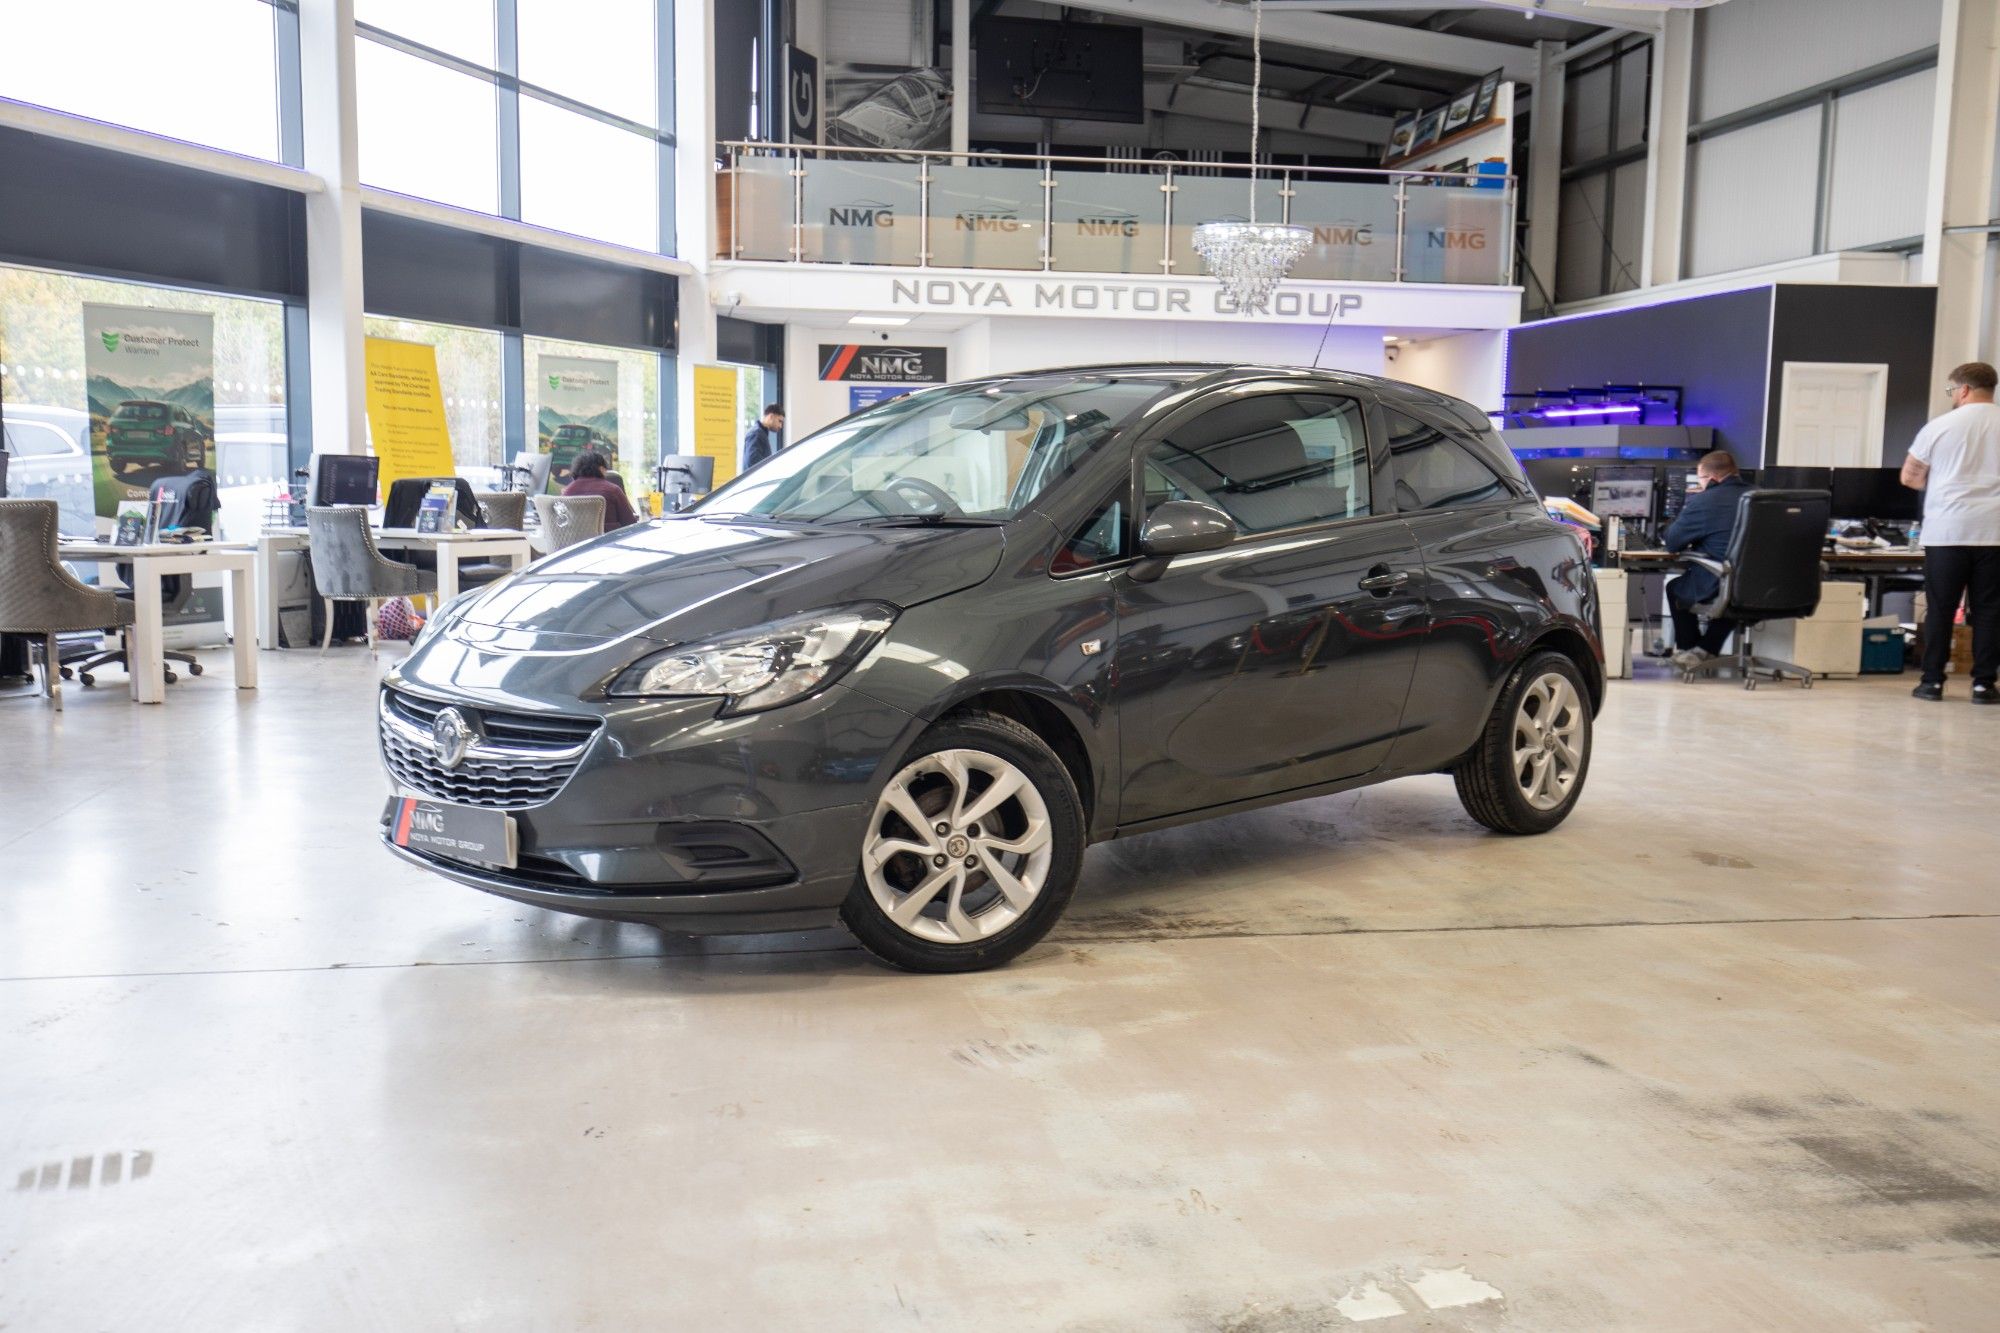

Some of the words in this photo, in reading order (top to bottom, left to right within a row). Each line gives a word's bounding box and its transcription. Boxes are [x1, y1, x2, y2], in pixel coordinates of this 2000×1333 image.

[829, 207, 894, 228] NMG
[955, 213, 1019, 233] NMG
[1077, 218, 1140, 237] NMG
[1313, 226, 1373, 246] NMG
[1427, 231, 1486, 249] NMG
[892, 279, 1012, 307] NOYA
[1035, 284, 1191, 312] MOTOR
[124, 334, 166, 346] Customer
[168, 337, 200, 347] Protect
[860, 356, 923, 375] NMG
[409, 810, 445, 833] NMG
[410, 832, 430, 843] NOYA
[430, 836, 457, 848] MOTOR
[458, 840, 485, 852] GROUP
